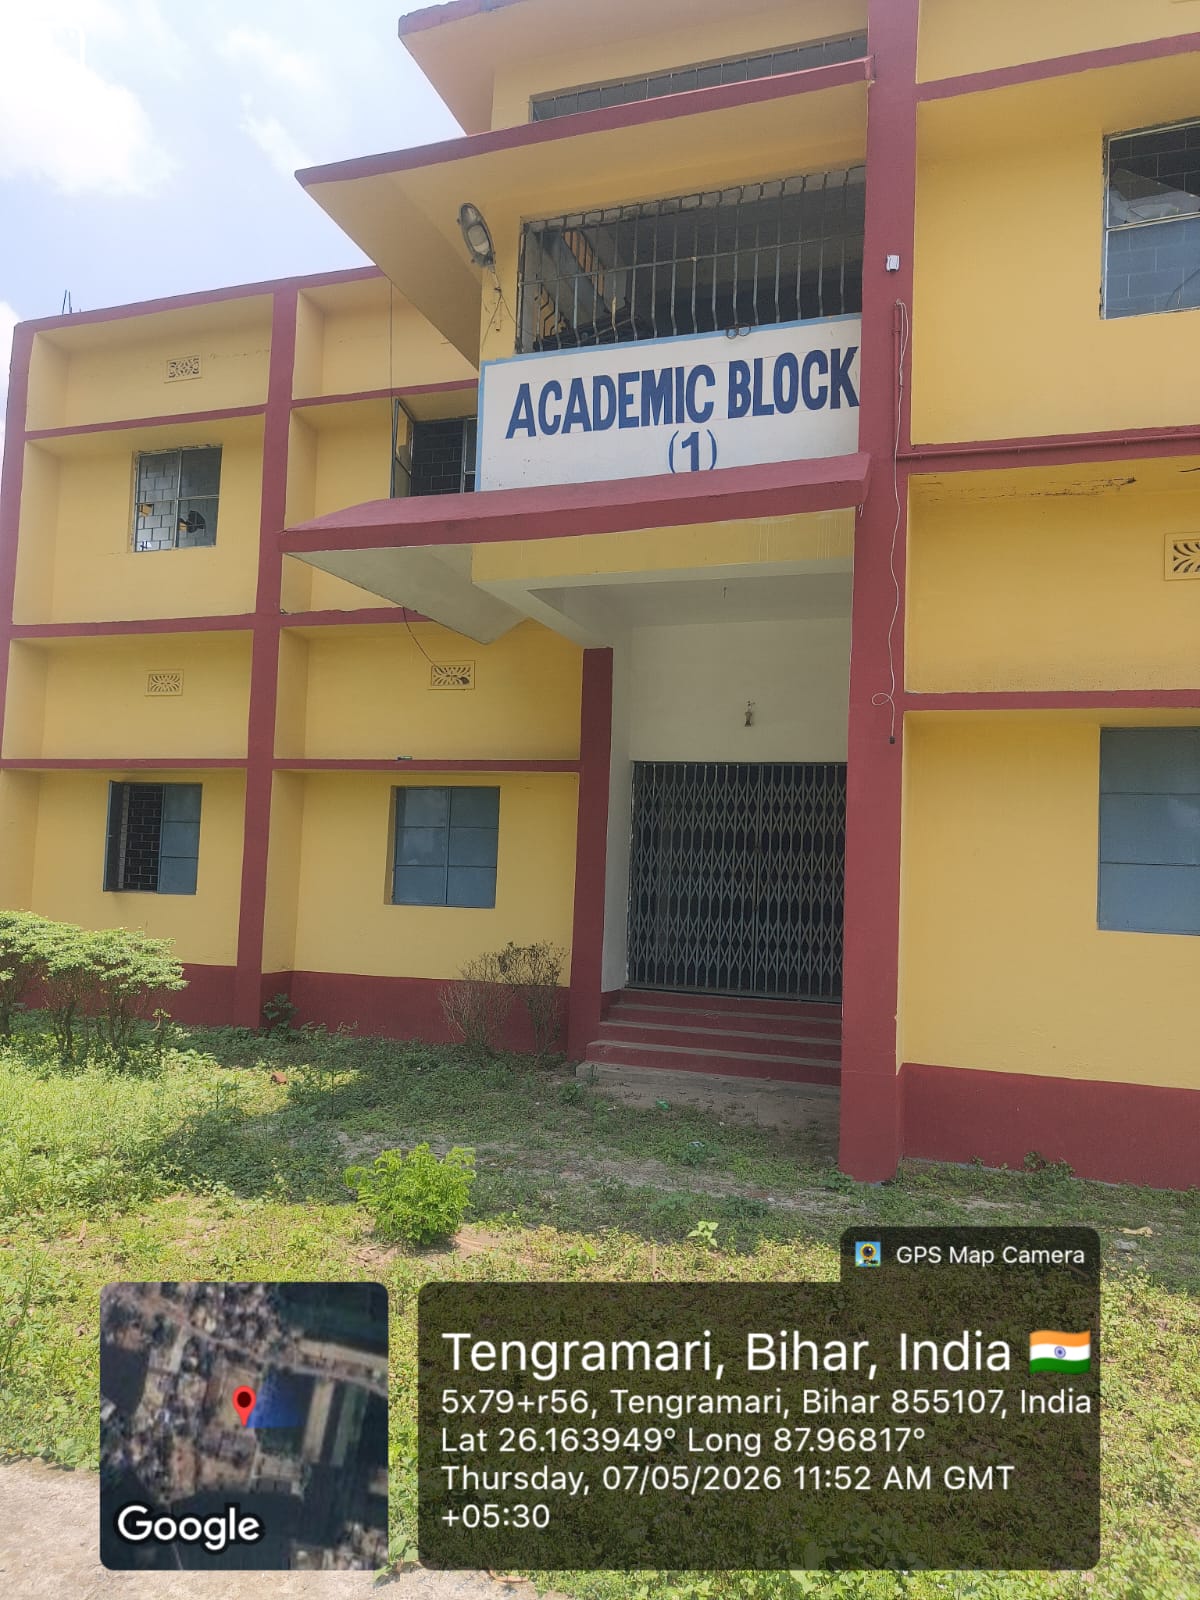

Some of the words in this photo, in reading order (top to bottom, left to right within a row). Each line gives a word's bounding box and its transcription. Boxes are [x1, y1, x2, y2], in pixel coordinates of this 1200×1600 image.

[505, 364, 716, 440] ACADEMIC
[728, 345, 860, 420] BLOCK
[668, 429, 718, 474] (1)
